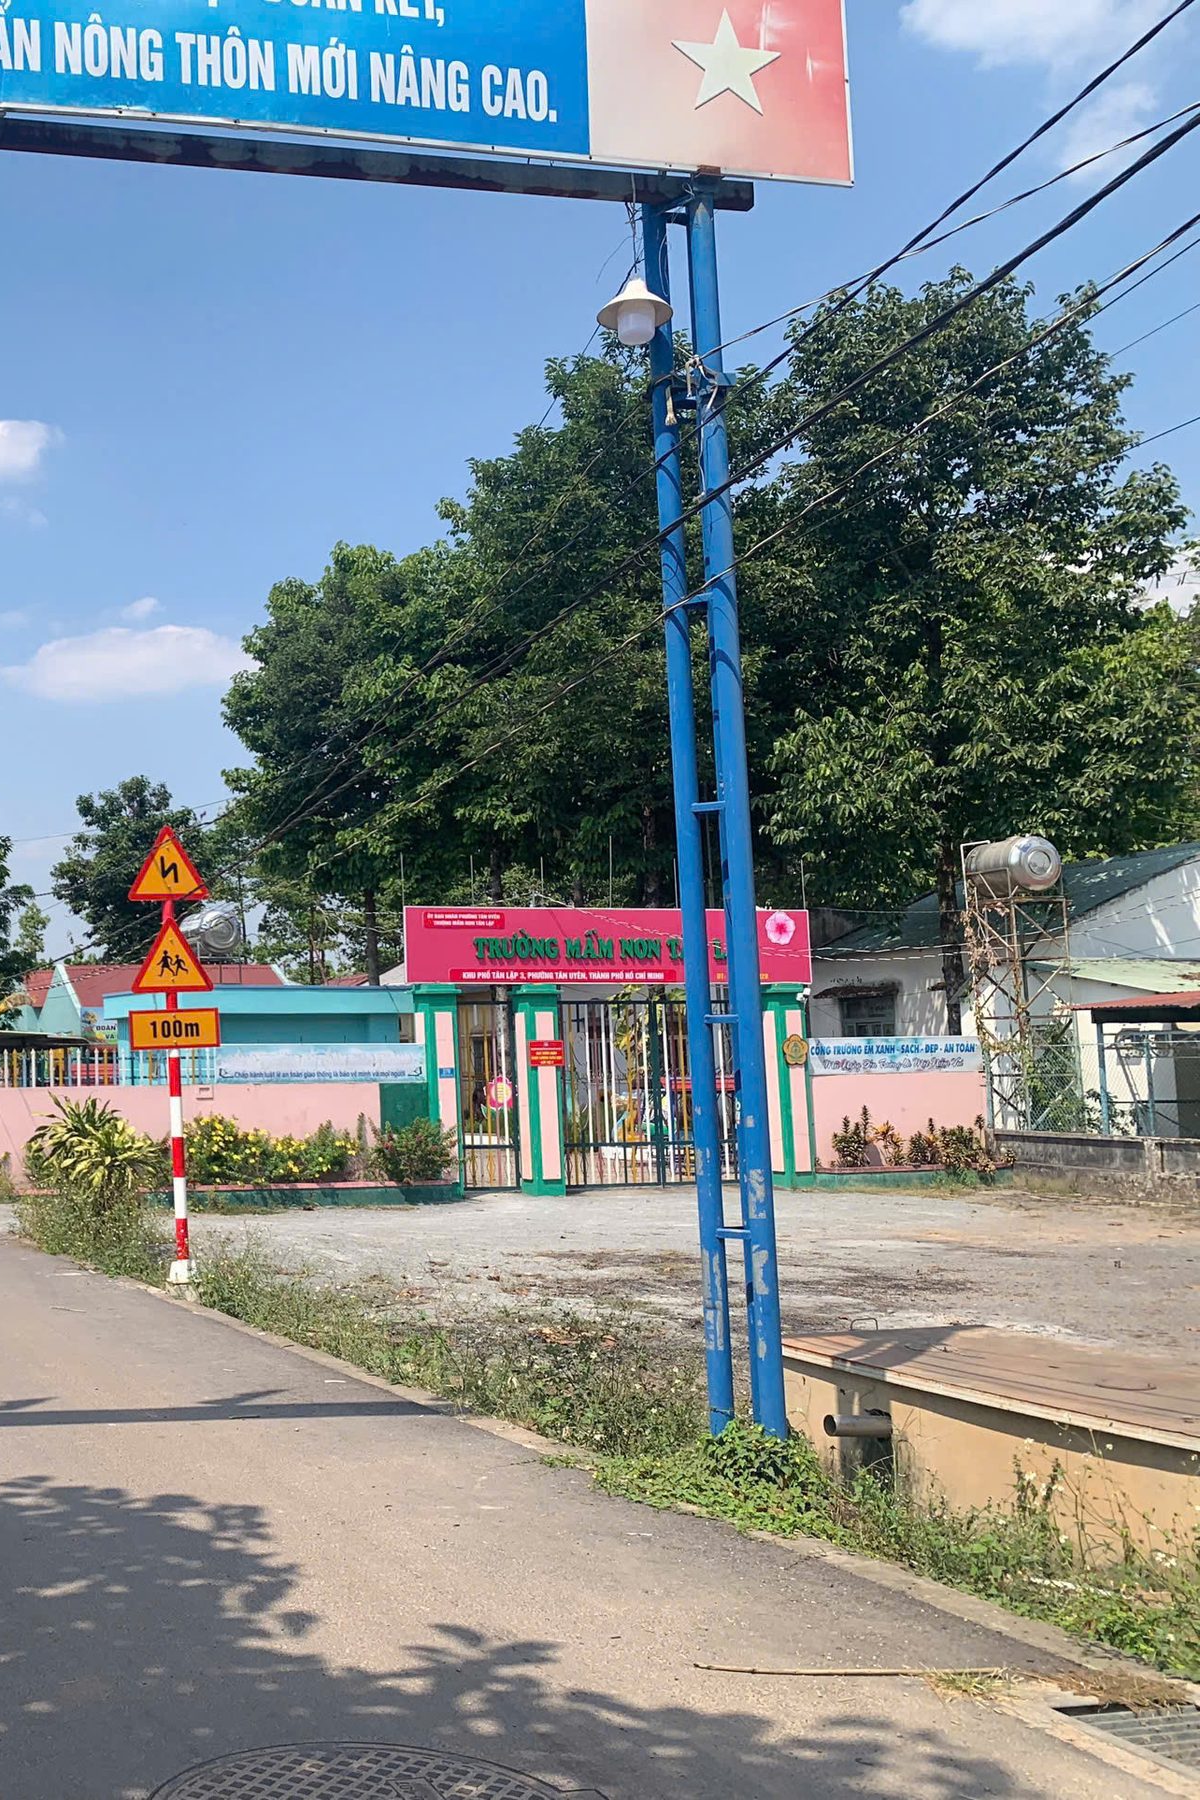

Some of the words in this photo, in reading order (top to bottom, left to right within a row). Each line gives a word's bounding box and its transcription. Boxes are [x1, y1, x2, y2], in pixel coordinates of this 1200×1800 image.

[54, 13, 164, 82] NÔNG
[175, 25, 275, 91] THÔN
[286, 37, 358, 101] MỚI
[369, 45, 471, 113] NÂNG
[481, 64, 558, 123] CAO.
[474, 929, 558, 959] TRƯỜNG
[565, 930, 614, 959] MẦM
[619, 938, 662, 959] NON
[462, 972, 476, 980] KHU
[477, 970, 490, 980] PHỐ
[491, 970, 505, 980] TÂN
[506, 970, 519, 981] LẬP
[527, 970, 554, 980] PHƯỜNG
[555, 970, 568, 980] TÂN
[588, 970, 610, 980] THÀNH
[611, 969, 624, 980] PHỐ
[646, 971, 664, 980] MINH
[149, 1019, 201, 1039] 100m
[875, 1044, 896, 1054] XANH
